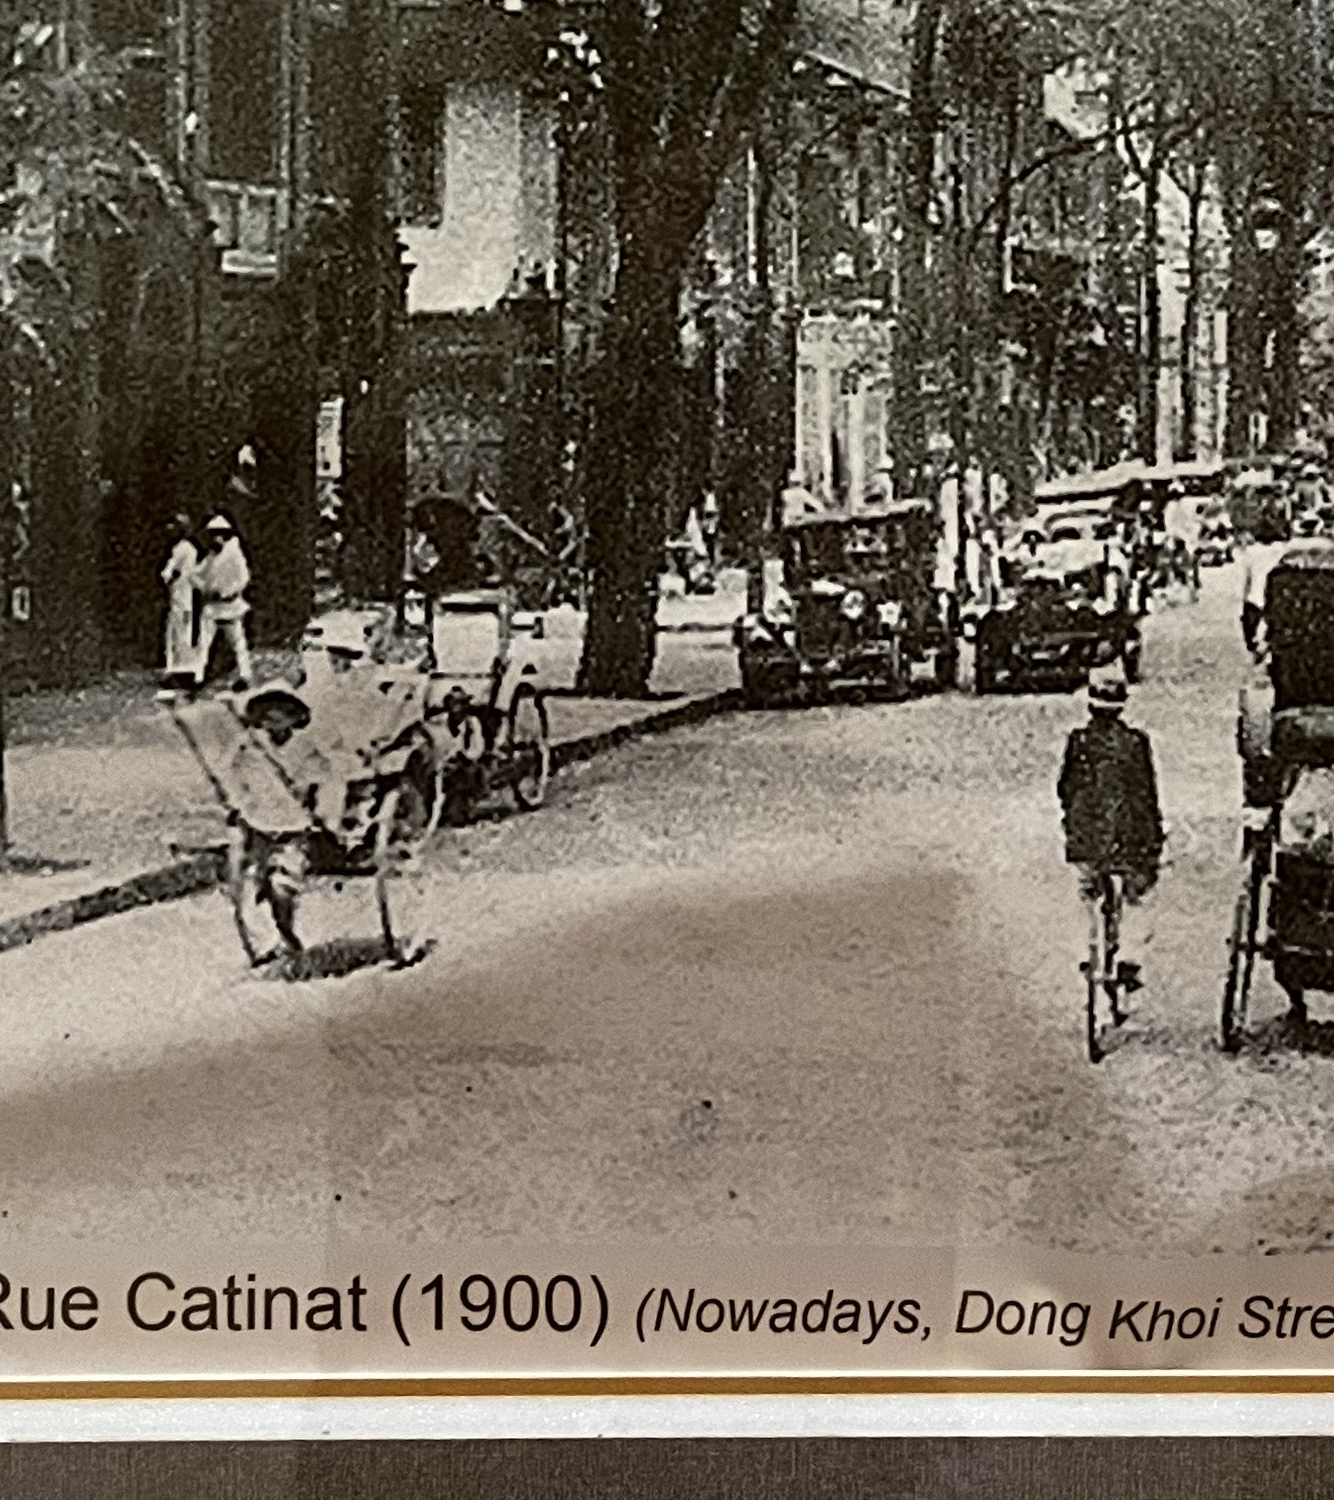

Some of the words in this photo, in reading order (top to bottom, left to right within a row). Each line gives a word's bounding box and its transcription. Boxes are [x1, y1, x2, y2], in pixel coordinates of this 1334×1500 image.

[127, 1271, 368, 1332] Catinat
[392, 1273, 609, 1347] (1900)
[636, 1287, 931, 1345] (Nowadays,
[955, 1290, 1092, 1347] Dong
[1108, 1297, 1224, 1343] Khoi
